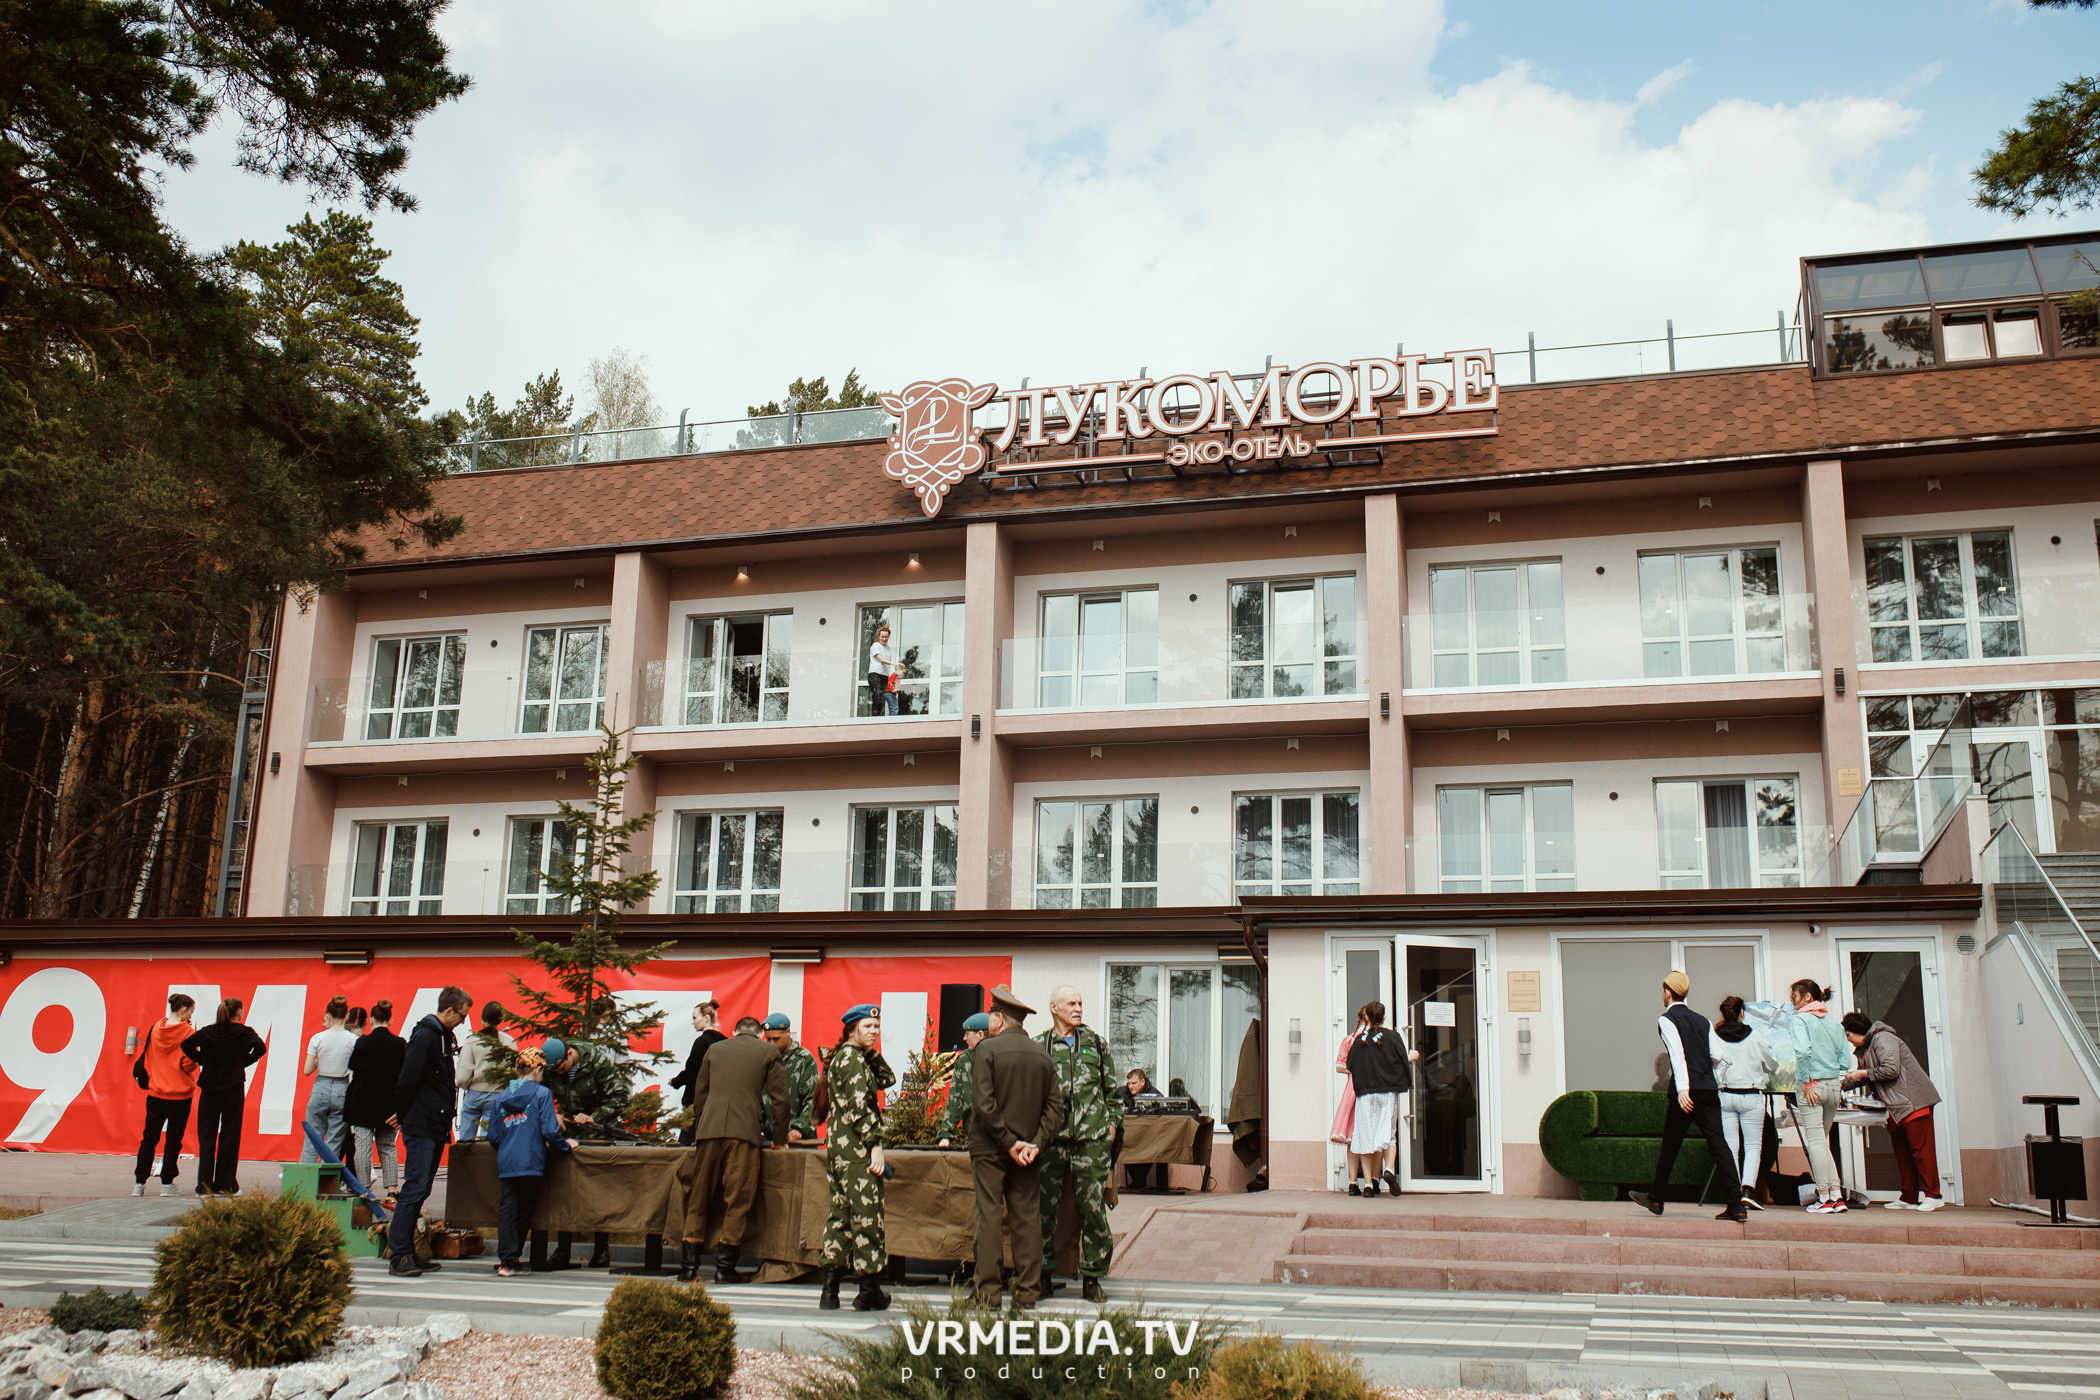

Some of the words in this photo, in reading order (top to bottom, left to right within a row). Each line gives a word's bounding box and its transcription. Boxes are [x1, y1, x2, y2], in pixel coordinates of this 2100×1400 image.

[994, 348, 1499, 451] ЛУКОМОРЬЕ
[1167, 434, 1312, 466] ЭКО-ОТЕЛЬ
[2, 967, 107, 1143] 9
